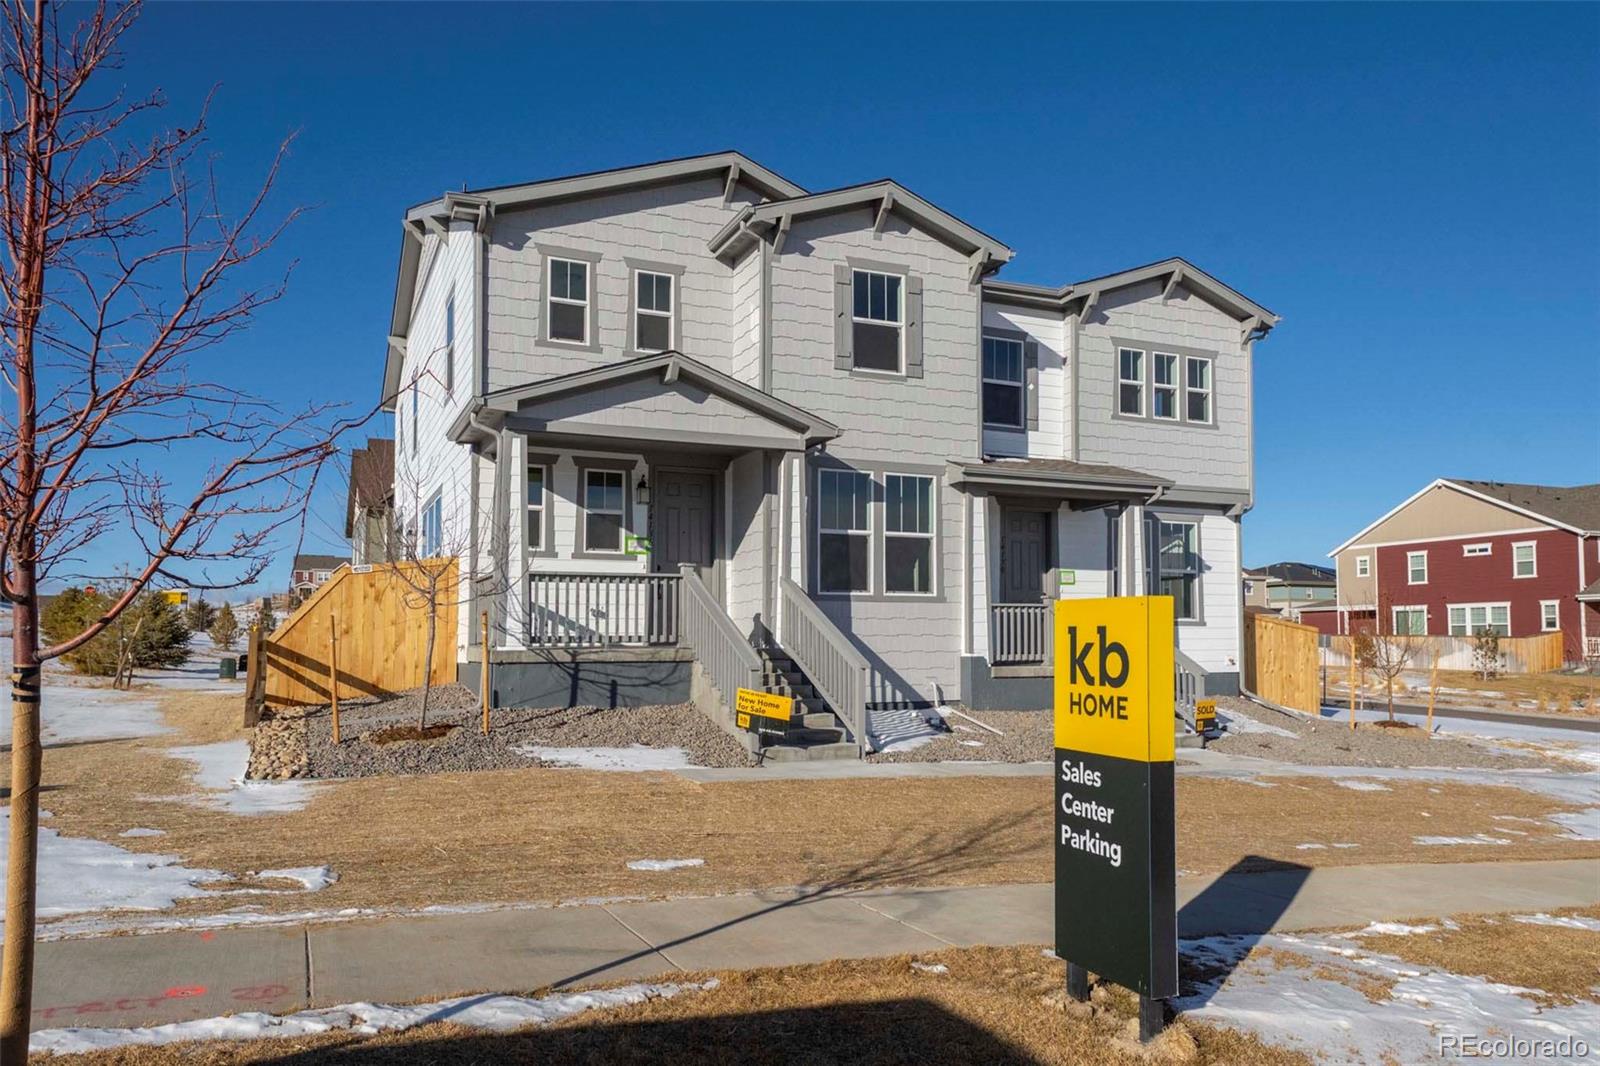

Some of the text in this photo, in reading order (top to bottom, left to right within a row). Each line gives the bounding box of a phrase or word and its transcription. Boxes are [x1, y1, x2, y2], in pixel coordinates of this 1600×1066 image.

[1068, 626, 1130, 688] kb
[738, 696, 780, 710] New Home
[738, 702, 766, 715] for Sale
[1070, 692, 1129, 720] HOME
[1197, 706, 1214, 715] SOLD
[1062, 760, 1101, 787] Sales
[1061, 792, 1114, 824] Center
[1062, 824, 1121, 867] Parking
